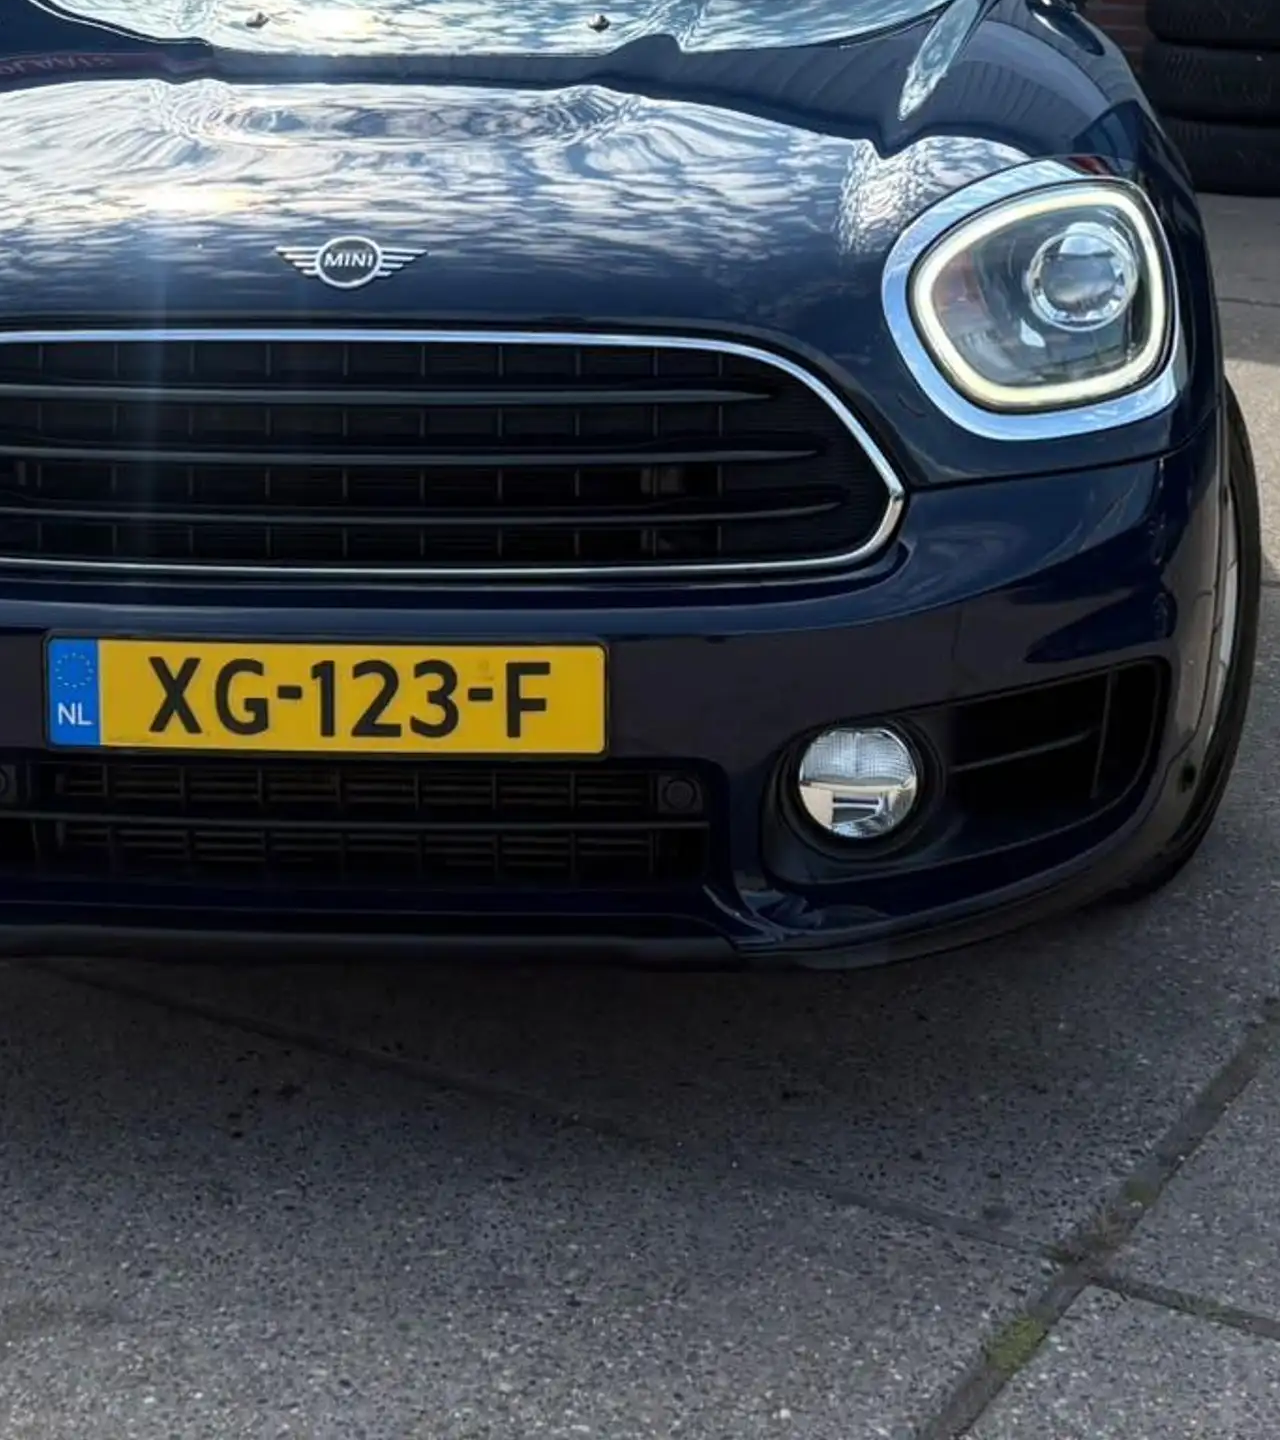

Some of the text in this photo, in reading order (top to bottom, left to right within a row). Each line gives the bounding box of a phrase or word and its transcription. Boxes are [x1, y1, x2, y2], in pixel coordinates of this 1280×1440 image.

[323, 251, 373, 268] MINI
[57, 656, 552, 740] NL XG-123-F
